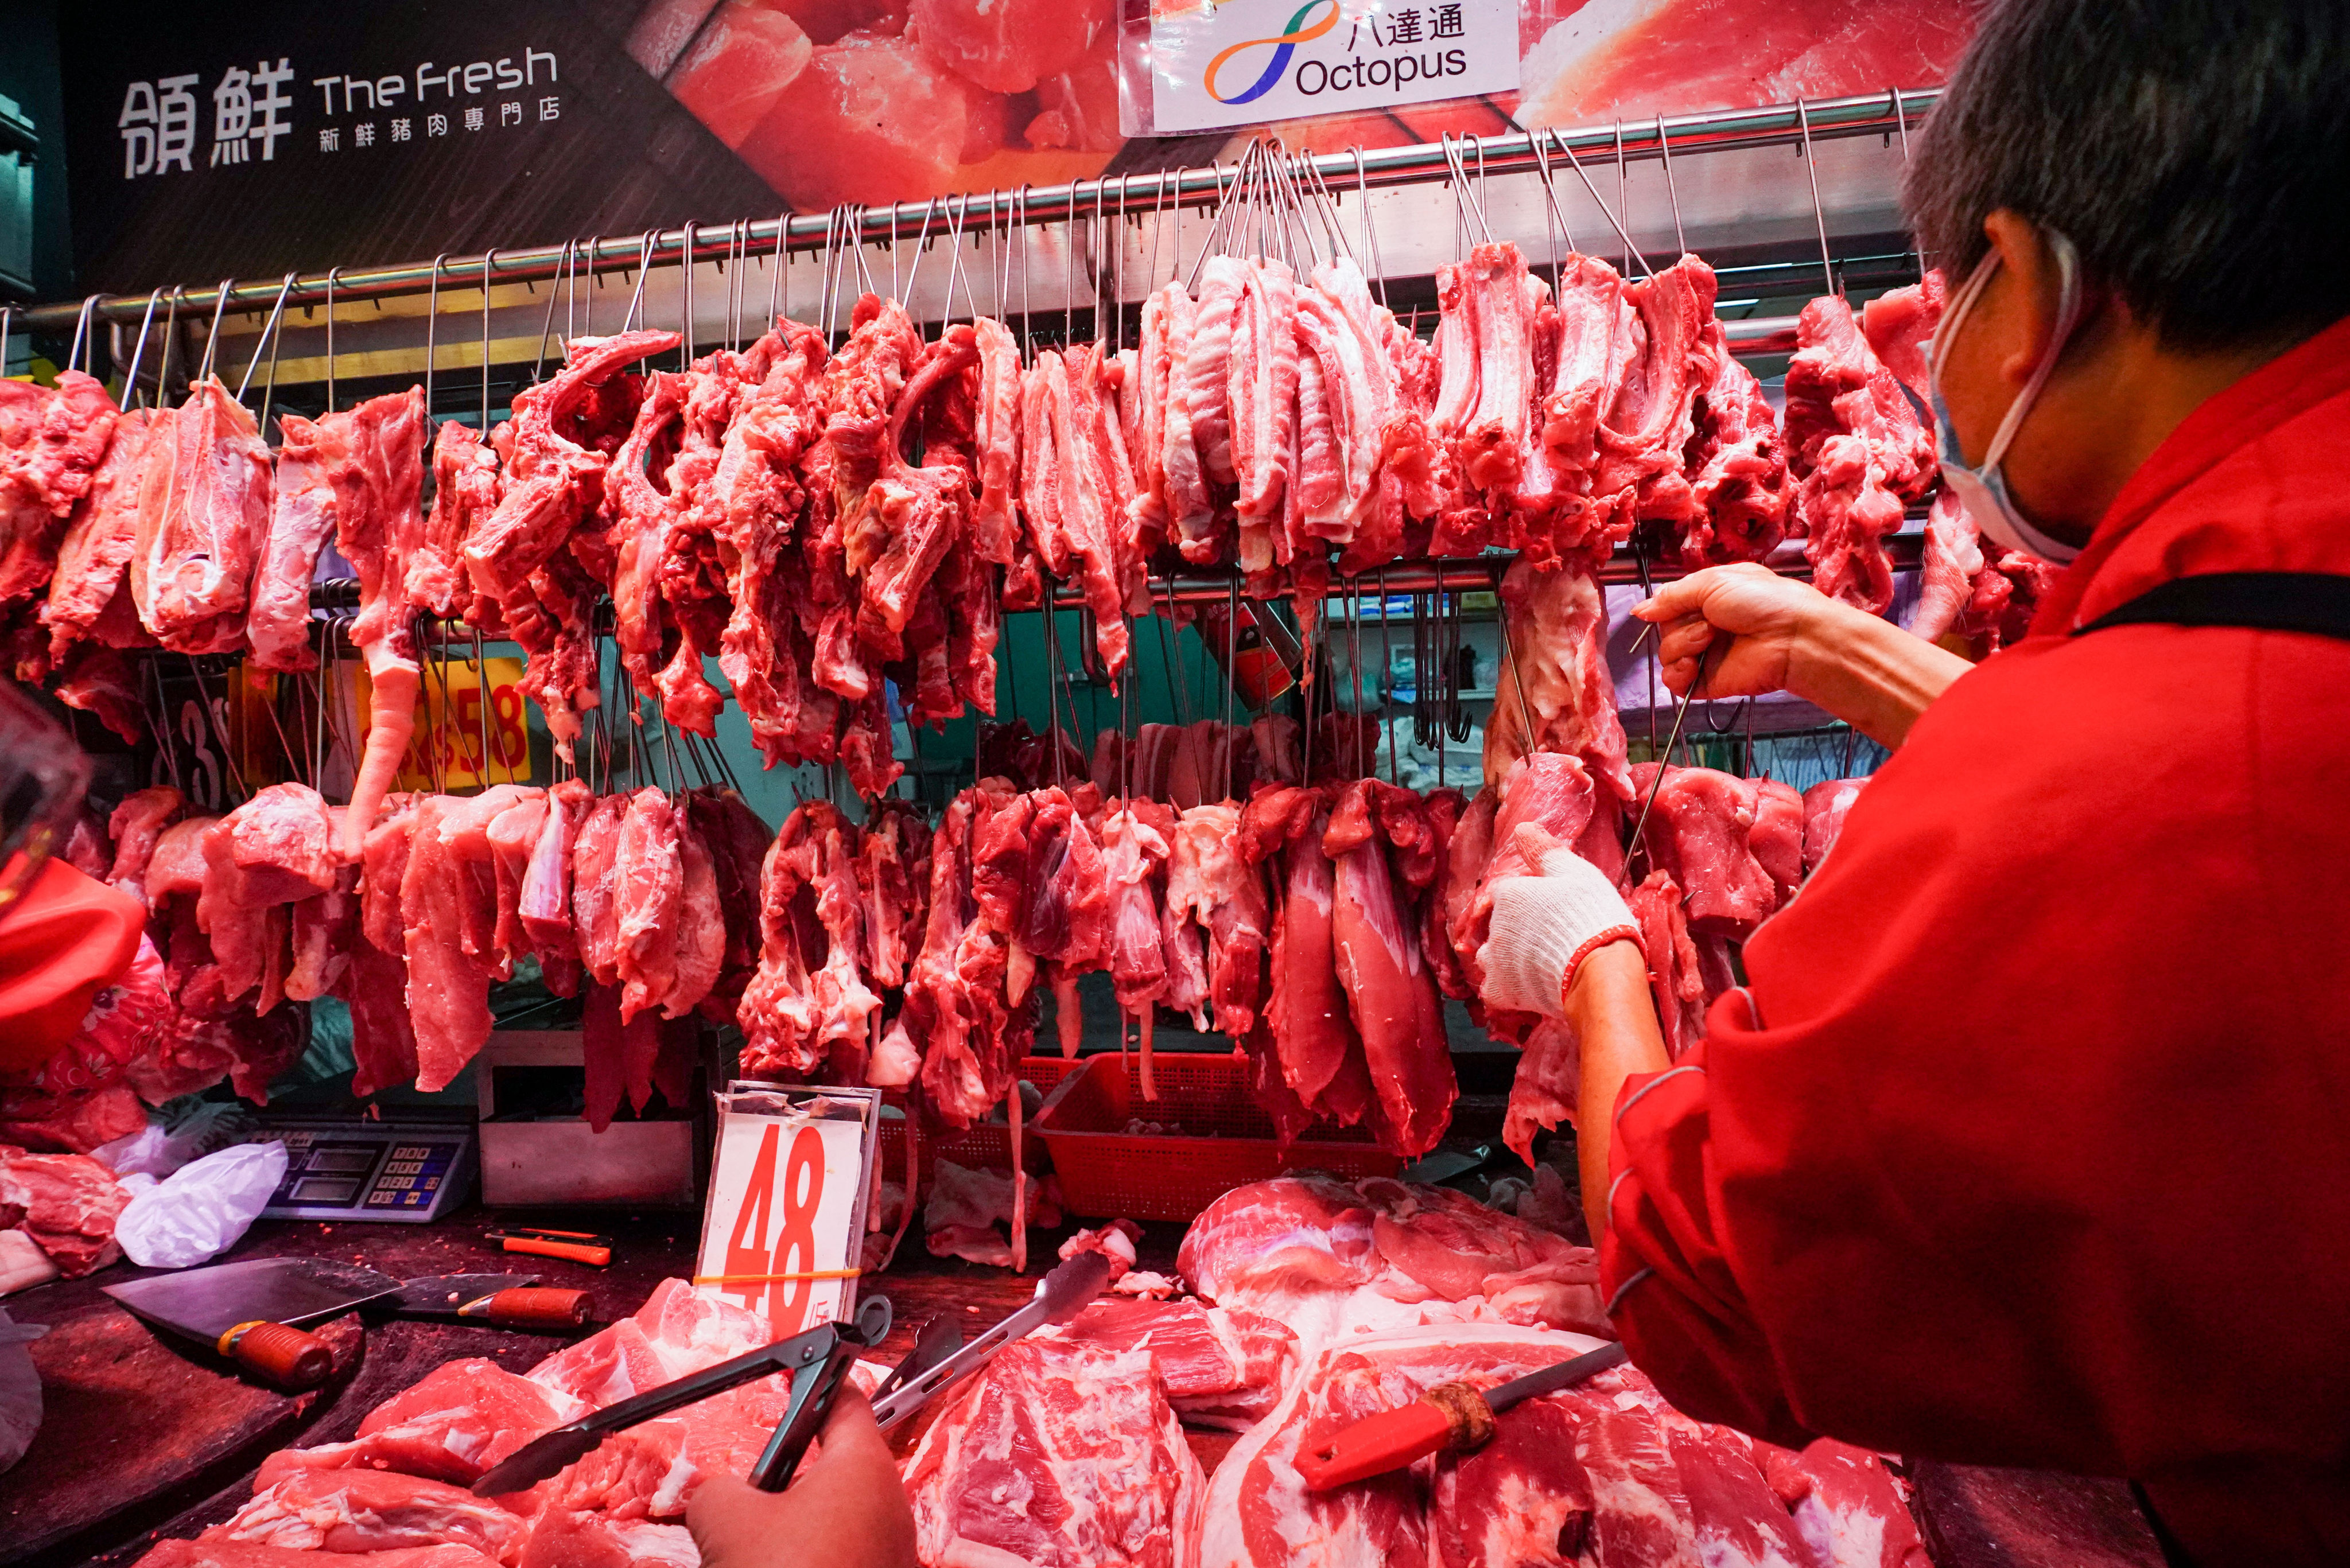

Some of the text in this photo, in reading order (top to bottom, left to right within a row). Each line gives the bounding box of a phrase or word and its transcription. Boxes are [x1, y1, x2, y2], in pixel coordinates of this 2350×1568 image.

[1347, 3, 1465, 53] 八達通
[314, 47, 558, 115] The Fresh
[1296, 49, 1466, 95] Octopus
[119, 58, 294, 179] 領鮮
[319, 96, 560, 152] 新鮮豬肉專門店
[721, 1124, 825, 1340] 48
